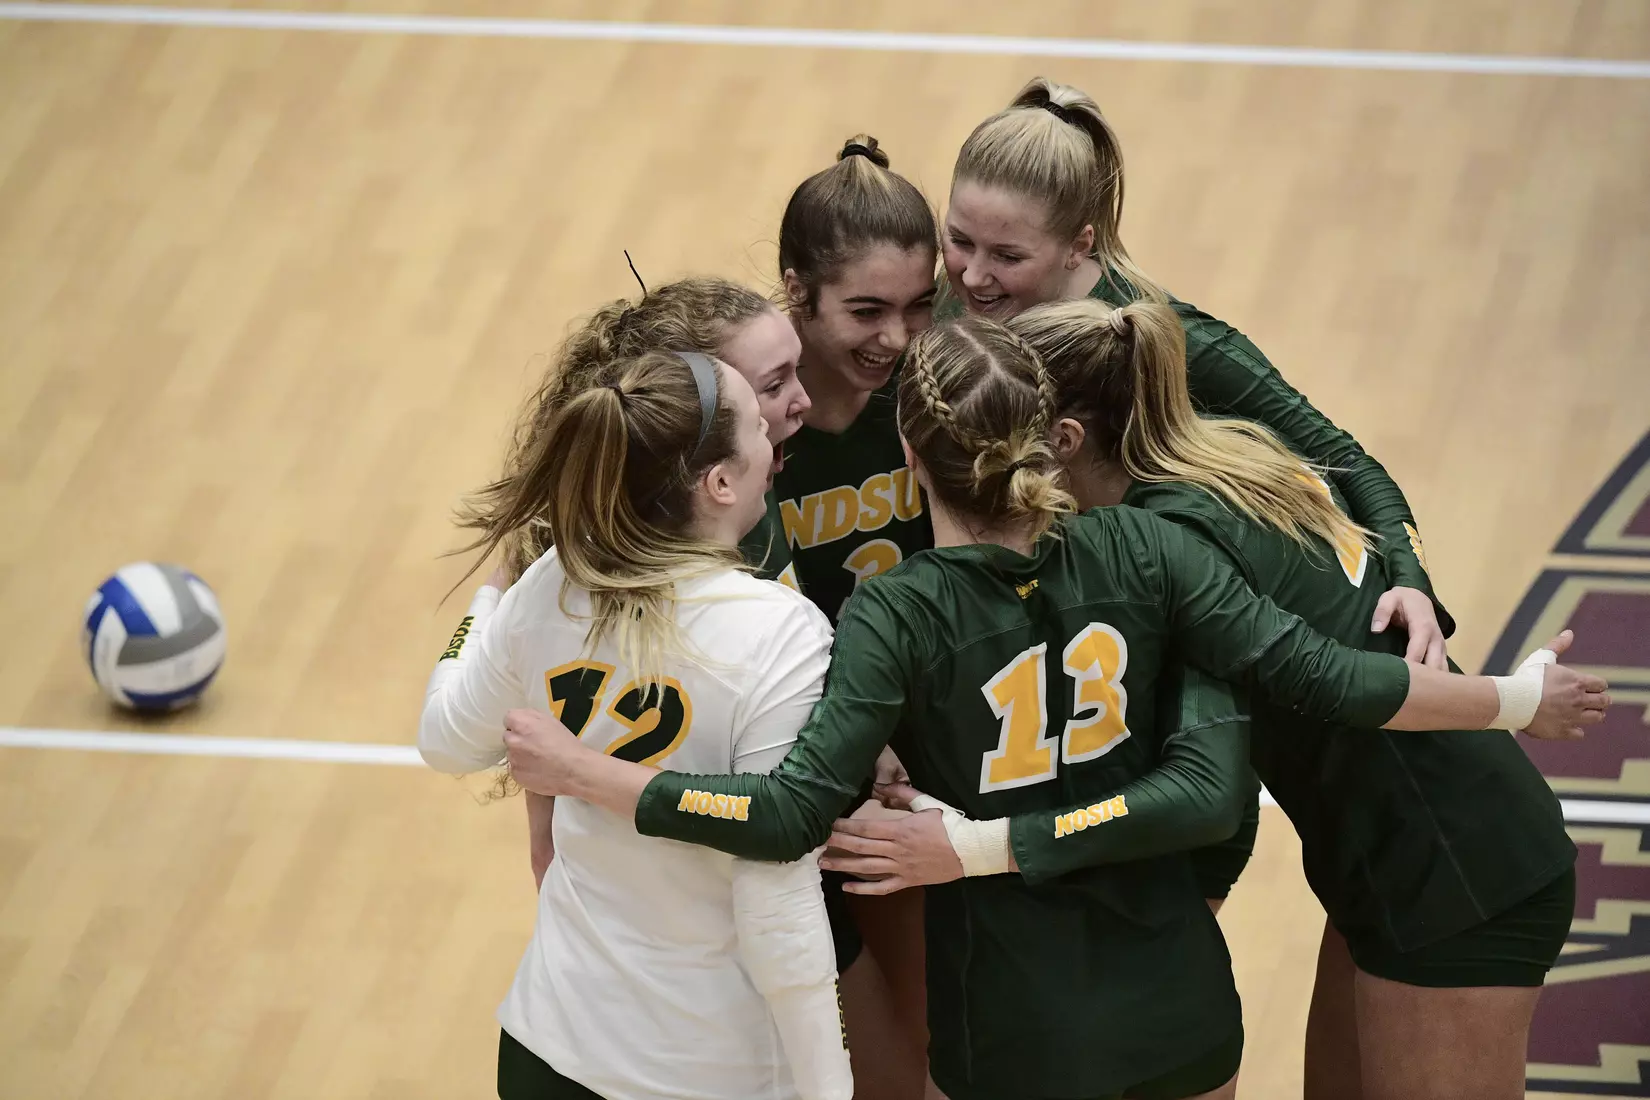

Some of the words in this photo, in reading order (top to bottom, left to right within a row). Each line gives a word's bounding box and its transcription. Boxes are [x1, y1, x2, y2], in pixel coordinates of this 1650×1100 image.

[779, 466, 923, 551] NDSU
[437, 615, 475, 663] BISON
[544, 659, 693, 770] 12
[979, 622, 1131, 794] 13
[677, 788, 752, 822] BISON
[1055, 794, 1129, 839] BISON
